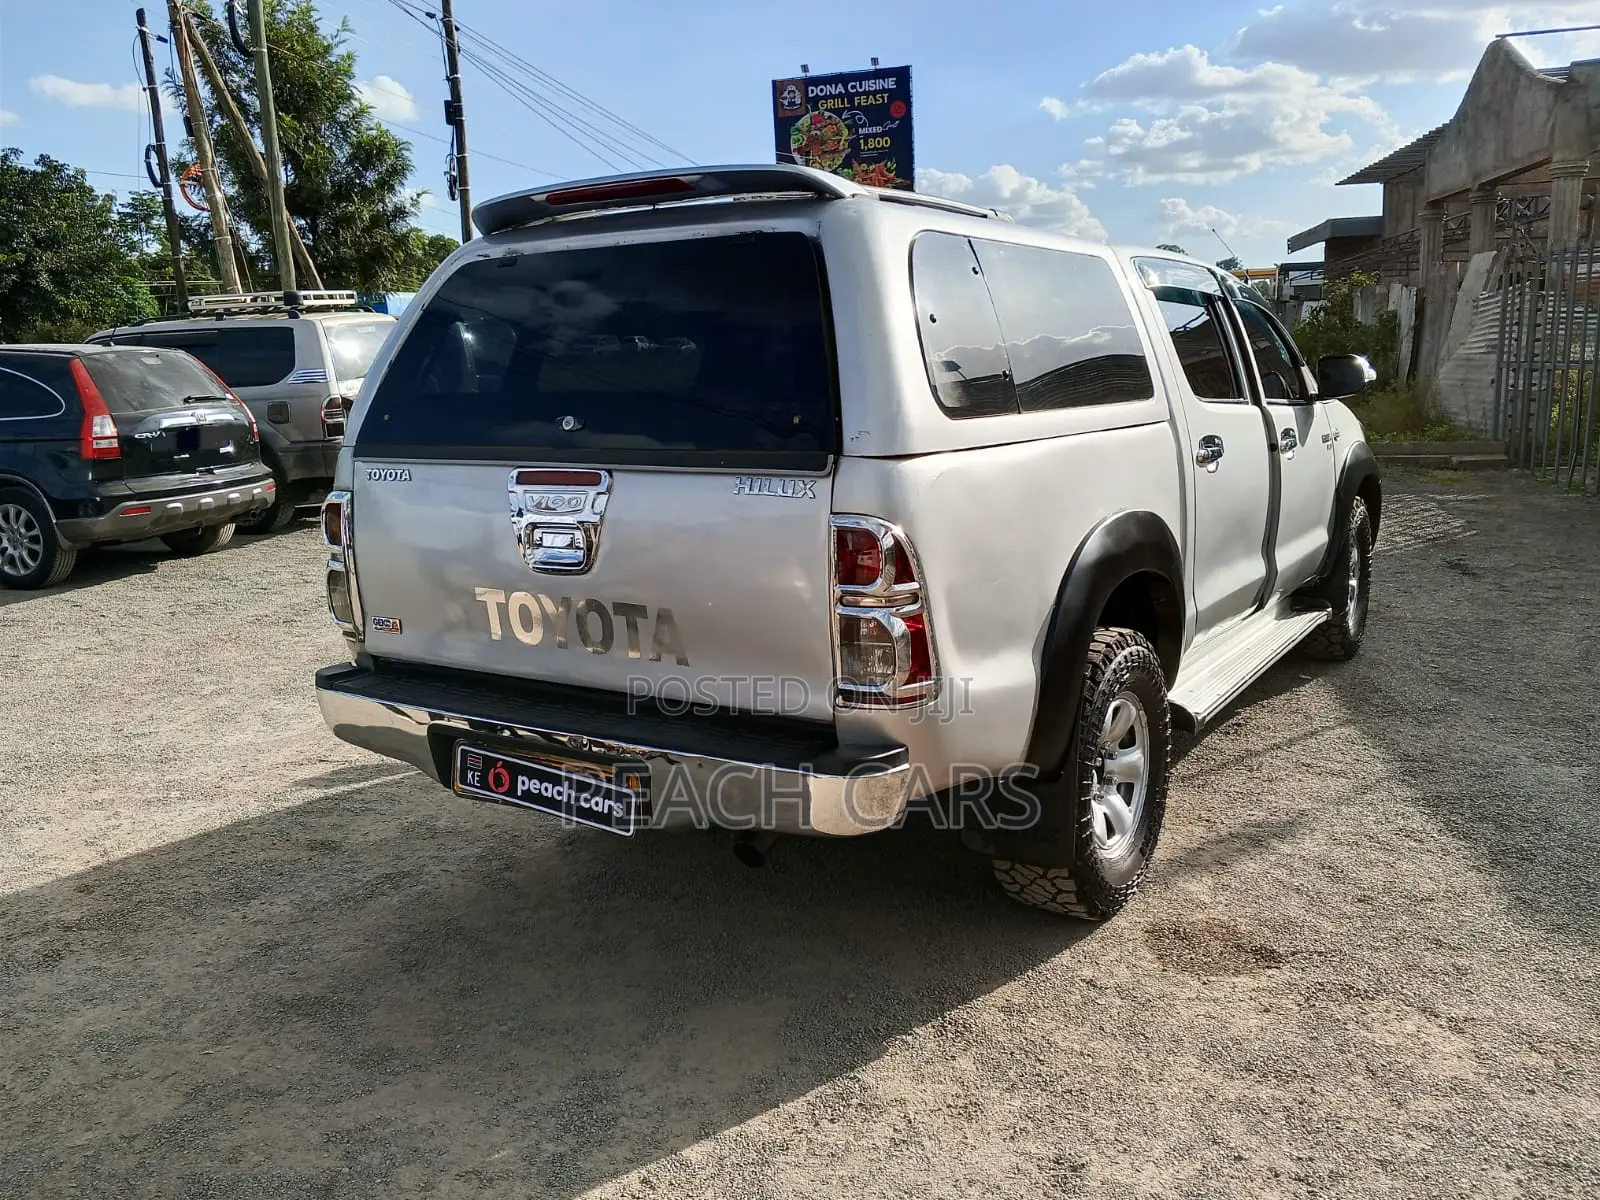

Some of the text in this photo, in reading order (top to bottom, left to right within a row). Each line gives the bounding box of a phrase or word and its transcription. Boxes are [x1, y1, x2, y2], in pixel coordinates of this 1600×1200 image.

[808, 77, 897, 98] DONA CUISINE
[818, 93, 889, 111] GRILL FEAST
[858, 126, 883, 135] MIXED
[859, 136, 891, 151] 1,800
[365, 469, 412, 481] TOYOTA
[733, 476, 817, 499] HILUX
[528, 495, 583, 509] VIGO
[475, 586, 690, 667] TOYOTA
[466, 770, 481, 787] KE
[517, 774, 625, 818] peach cars
